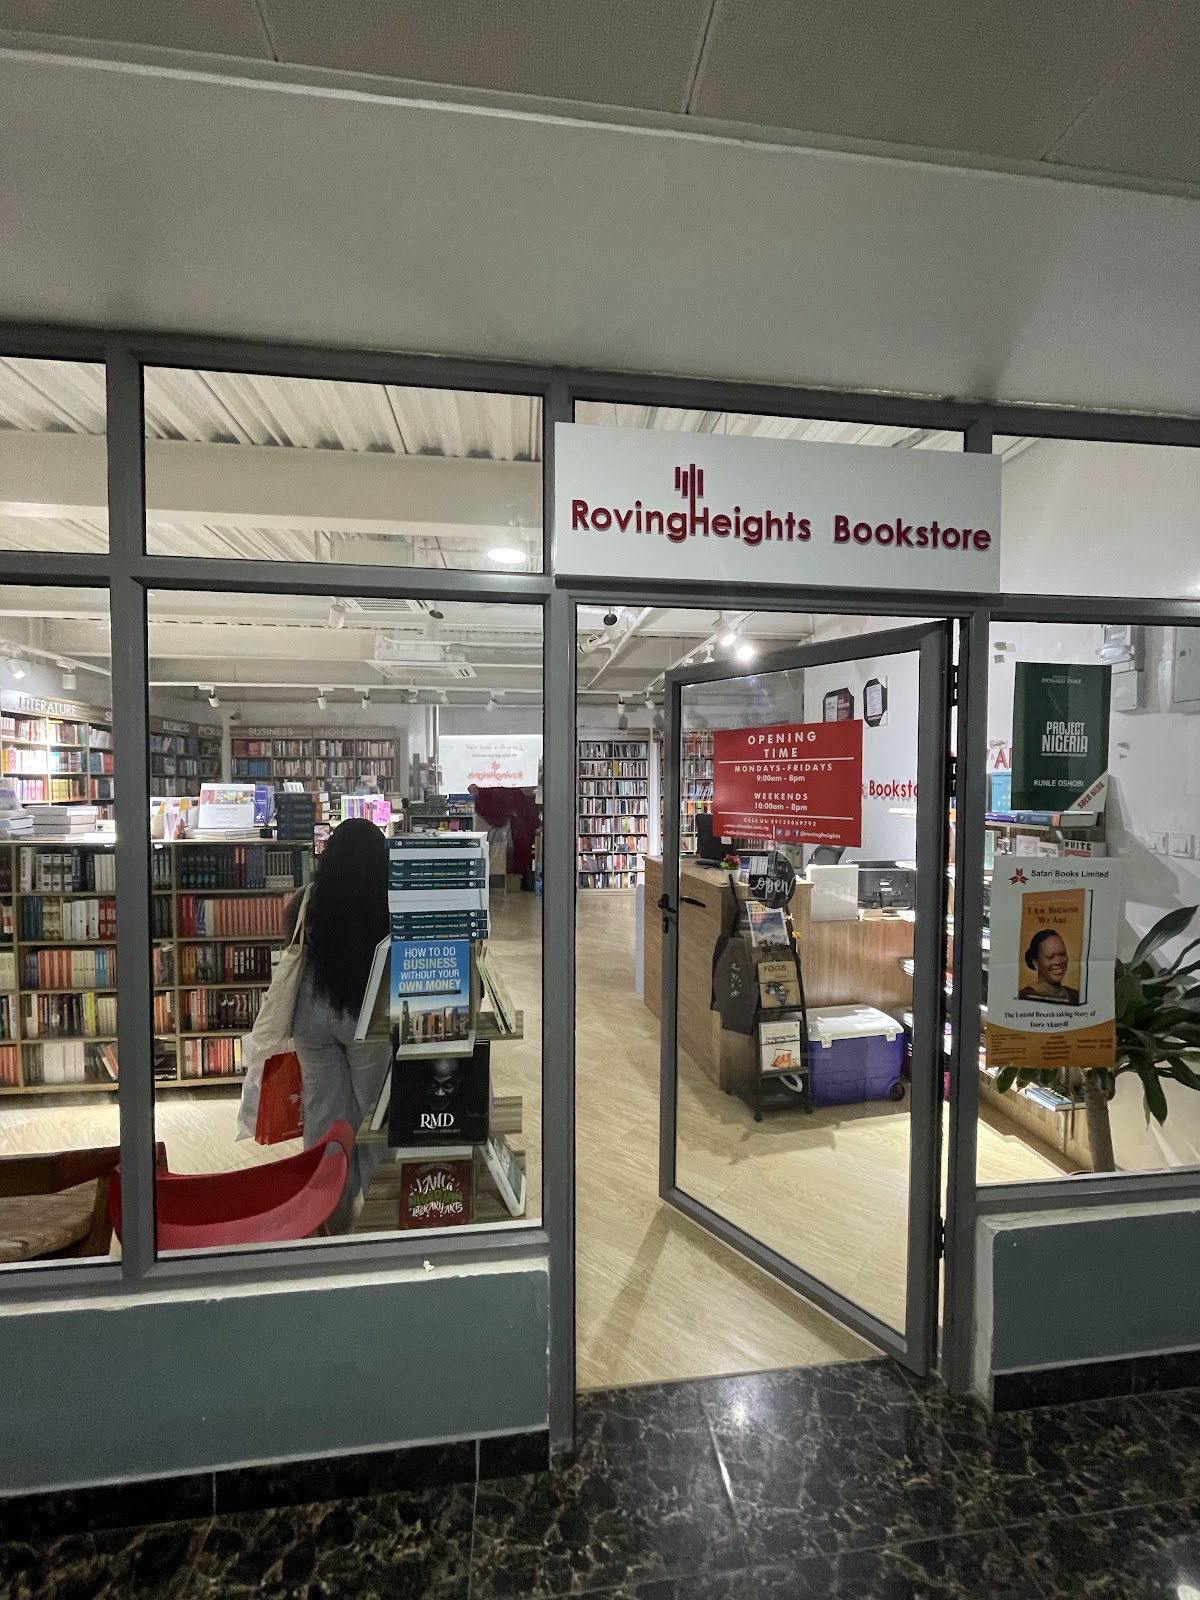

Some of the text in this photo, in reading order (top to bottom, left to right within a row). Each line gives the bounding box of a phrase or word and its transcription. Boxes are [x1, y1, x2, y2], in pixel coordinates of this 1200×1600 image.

[571, 498, 992, 551] RovingHeights Bookstore
[19, 697, 77, 716] LITERATURE
[248, 727, 294, 736] BUSINESS
[1046, 721, 1085, 735] PROJECT
[747, 731, 817, 745] OPENING
[1041, 735, 1089, 753] NIGERIA
[763, 747, 798, 759] TIME
[734, 763, 833, 773] MONDAYS-FRIDAYS
[756, 774, 782, 782] 9:00am
[788, 774, 805, 783] 8pm
[1033, 779, 1084, 787] KUNLE OSHOBI
[754, 792, 808, 801] WEEKENDS
[1077, 781, 1105, 809] SOLD HERE
[754, 802, 784, 810] 10:00am
[791, 803, 808, 812] 8pm
[1064, 840, 1092, 851] WHITE
[1031, 869, 1053, 877] Safari
[1081, 870, 1109, 878] Limited
[404, 946, 456, 958] HOW TO DO
[403, 957, 457, 970] BUSINESS
[763, 965, 787, 973] FOCUS
[400, 969, 460, 980] WITHOUT YOUR
[399, 978, 461, 992] OWN MONEY
[1074, 1010, 1088, 1018] Story
[420, 1112, 455, 1129] RMD
